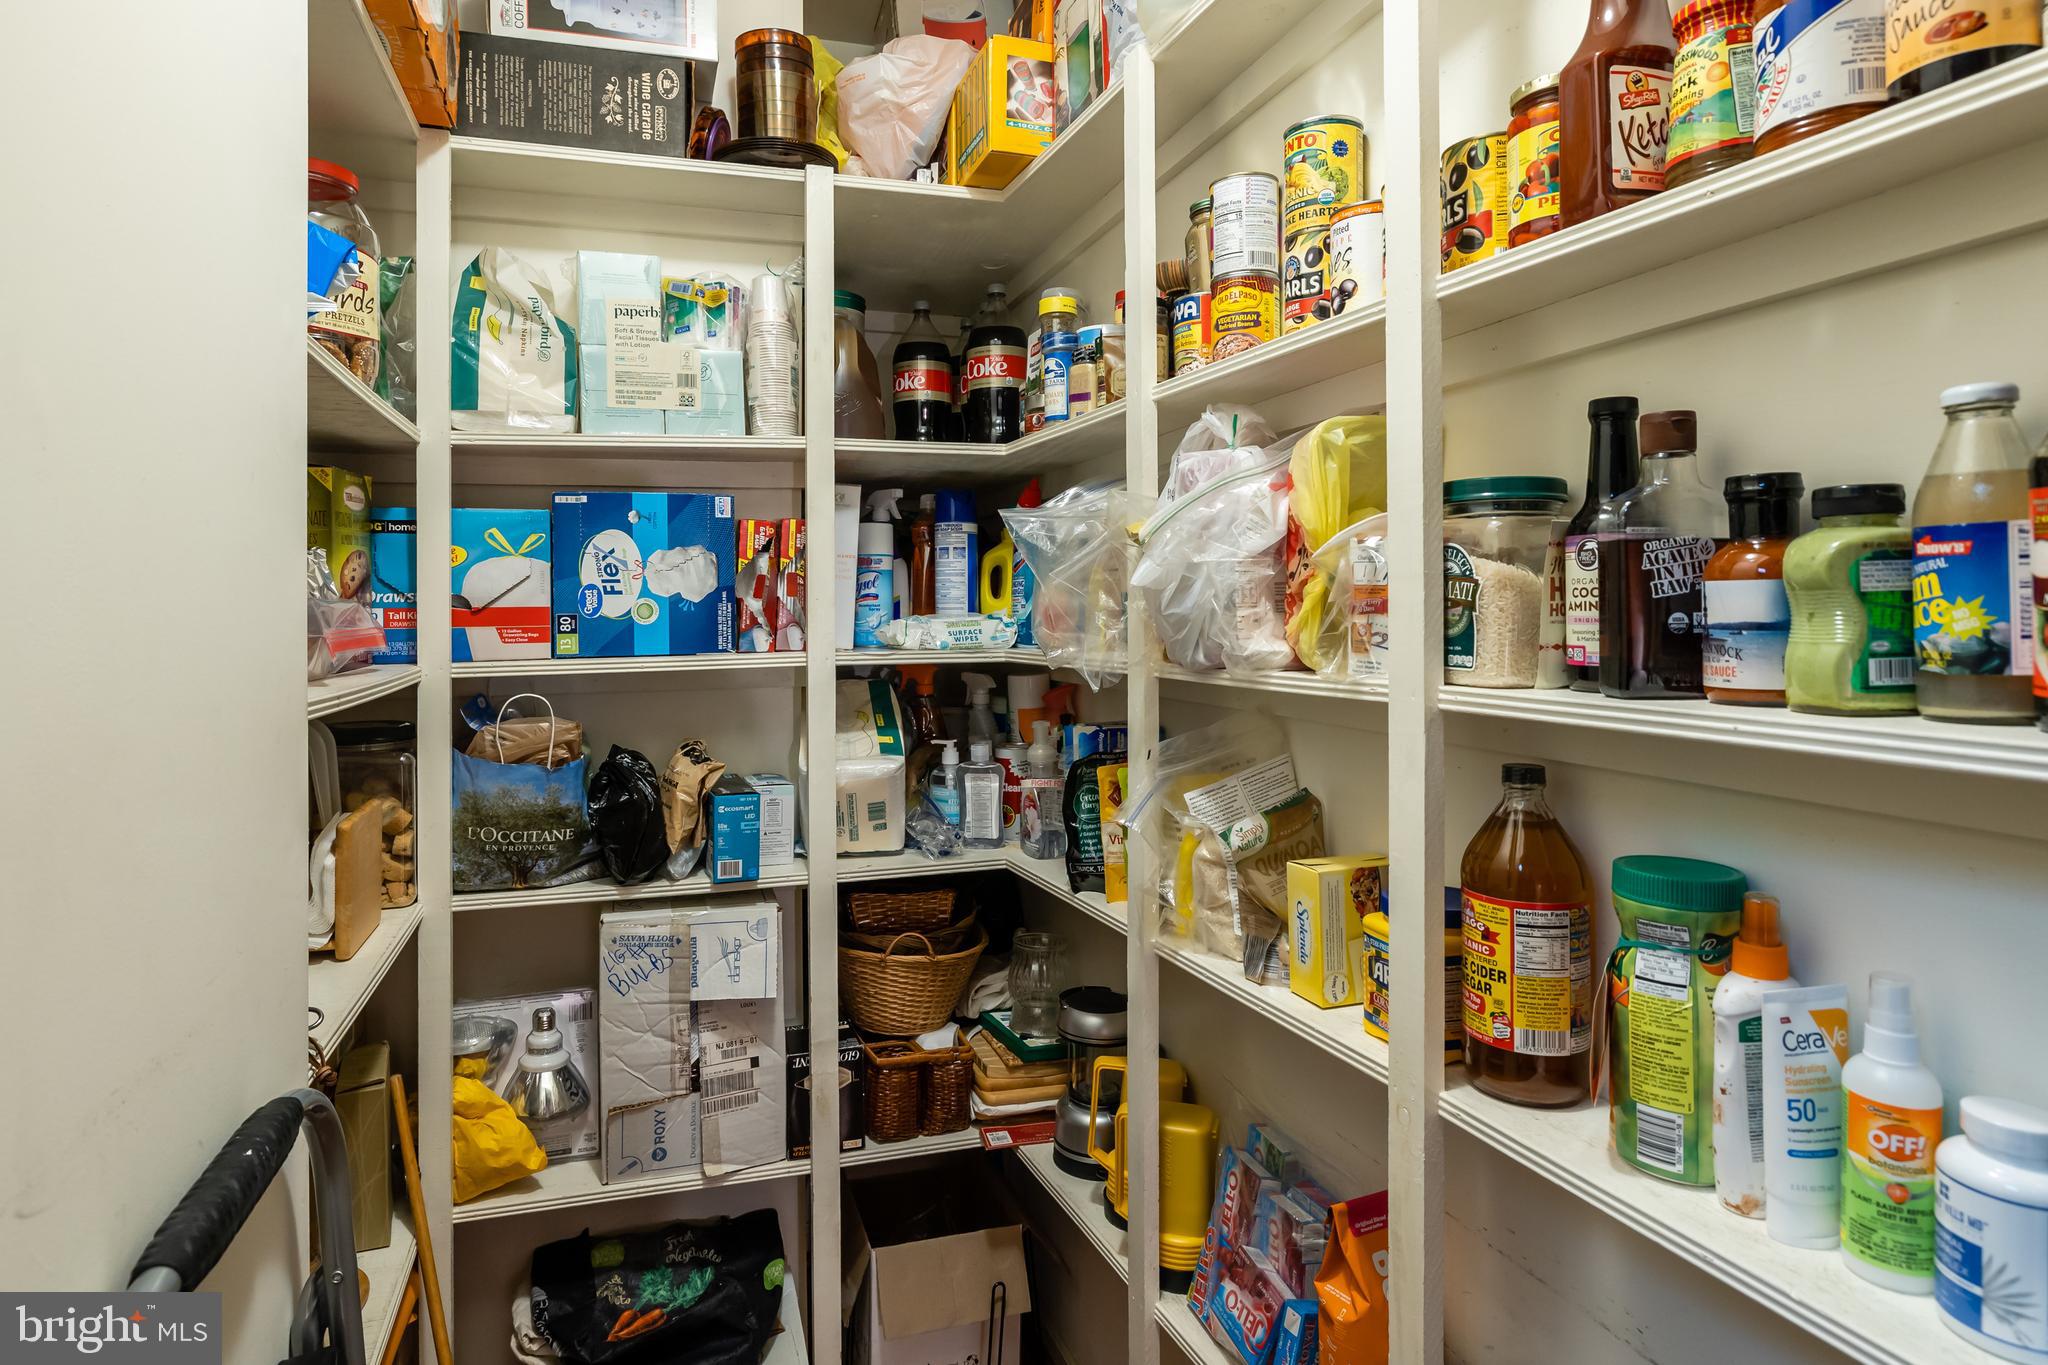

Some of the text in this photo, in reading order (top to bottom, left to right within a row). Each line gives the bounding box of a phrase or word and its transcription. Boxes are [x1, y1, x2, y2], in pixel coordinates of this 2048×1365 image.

[1623, 91, 1659, 107] ShopRite
[1762, 63, 1789, 118] SAUCE
[641, 73, 654, 140] wine carafe
[325, 311, 366, 327] PRETZELS
[1218, 314, 1257, 325] VEGETARIAN
[520, 328, 529, 357] Napkins
[967, 357, 1008, 380] Coke
[895, 371, 927, 392] oke
[1643, 535, 1697, 551] ORGANIC
[593, 551, 604, 578] STRONG
[1642, 546, 1700, 569] AGAVE
[592, 542, 629, 596] Flex
[1653, 565, 1674, 581] IN
[1650, 577, 1691, 598] RAW
[584, 590, 593, 614] Great
[388, 611, 402, 620] Tall
[560, 616, 571, 632] 80
[947, 629, 983, 637] SURFACE
[560, 639, 571, 650] 13
[1710, 666, 1736, 678] SAUCE
[725, 804, 754, 812] ecosmart
[468, 826, 575, 843] L'OCCITANE
[1236, 823, 1264, 842] Simply
[502, 844, 555, 852] PROVENCE
[1238, 834, 1264, 852] Nature
[1255, 837, 1322, 877] QUINOA
[1516, 910, 1549, 918] Nutrition
[1296, 901, 1310, 964] Splenda
[1637, 919, 1669, 931] Supplement
[618, 935, 675, 943] BOTH WAYS
[690, 937, 699, 988] patagonia
[607, 948, 674, 997] BULBS
[1470, 962, 1507, 985] CIDER
[716, 1042, 724, 1050] NJ
[1782, 1026, 1848, 1053] CeraVe
[1784, 1064, 1828, 1077] Hydrating
[1784, 1076, 1832, 1088] Sunscreen
[1787, 1098, 1817, 1123] 50
[654, 1109, 666, 1145] ROXY
[1867, 1127, 1927, 1159] OFF!
[1868, 1155, 1928, 1176] botanicals
